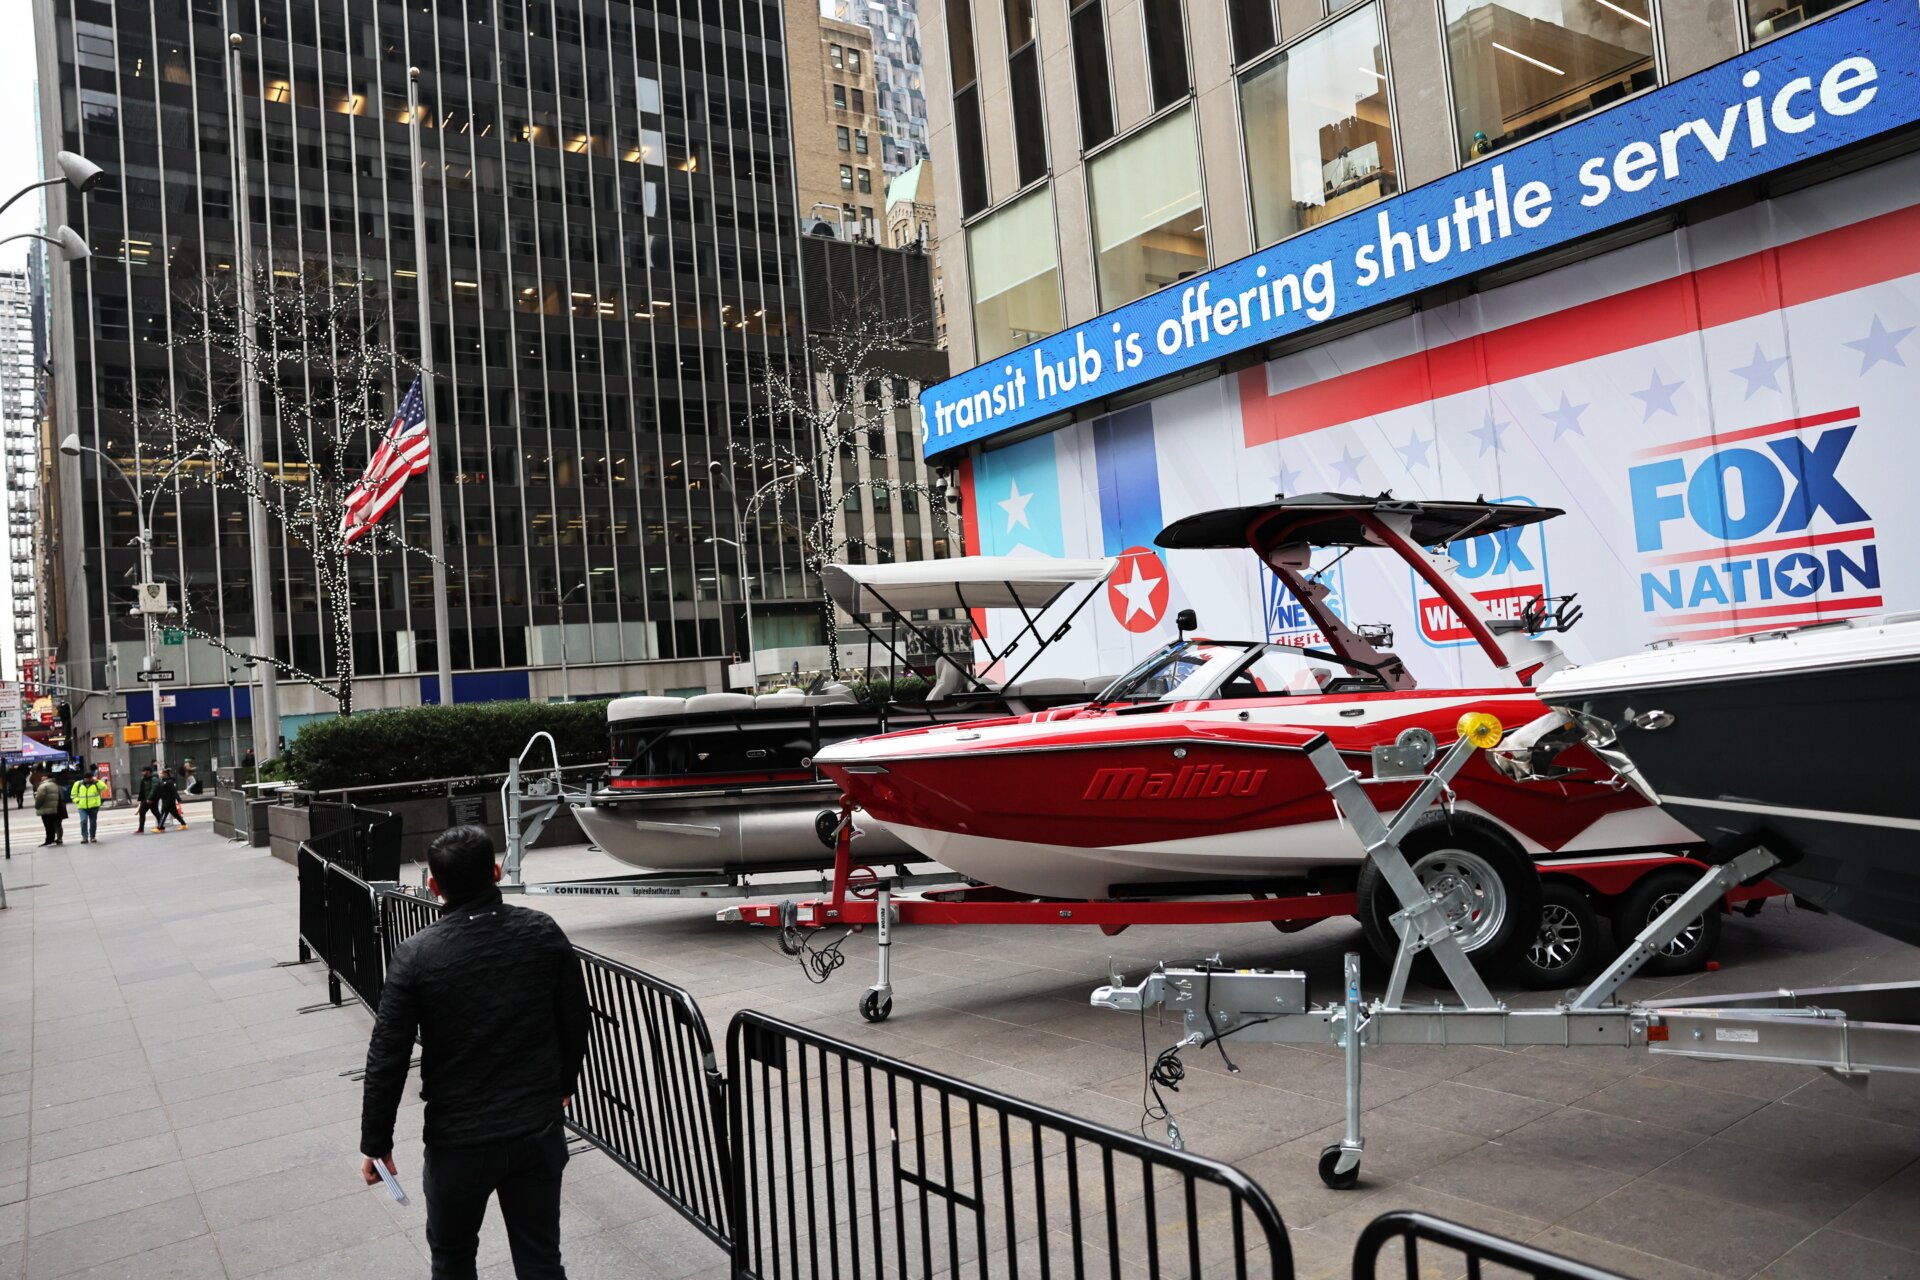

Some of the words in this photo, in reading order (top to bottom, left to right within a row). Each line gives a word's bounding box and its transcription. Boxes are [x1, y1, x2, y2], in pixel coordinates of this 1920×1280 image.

[935, 365, 1026, 437] transit
[1034, 331, 1102, 400] hub
[1112, 323, 1143, 372] is
[1156, 260, 1336, 355] offering
[1354, 163, 1553, 287] shuttle
[1579, 56, 1879, 207] service
[1628, 424, 1872, 553] FOX
[1424, 525, 1535, 585] OX
[1640, 544, 1881, 612] NATION
[1277, 599, 1342, 629] NES
[1276, 632, 1331, 648] digita
[1082, 764, 1269, 801] Malibu
[554, 887, 620, 896] CONTINENTAL
